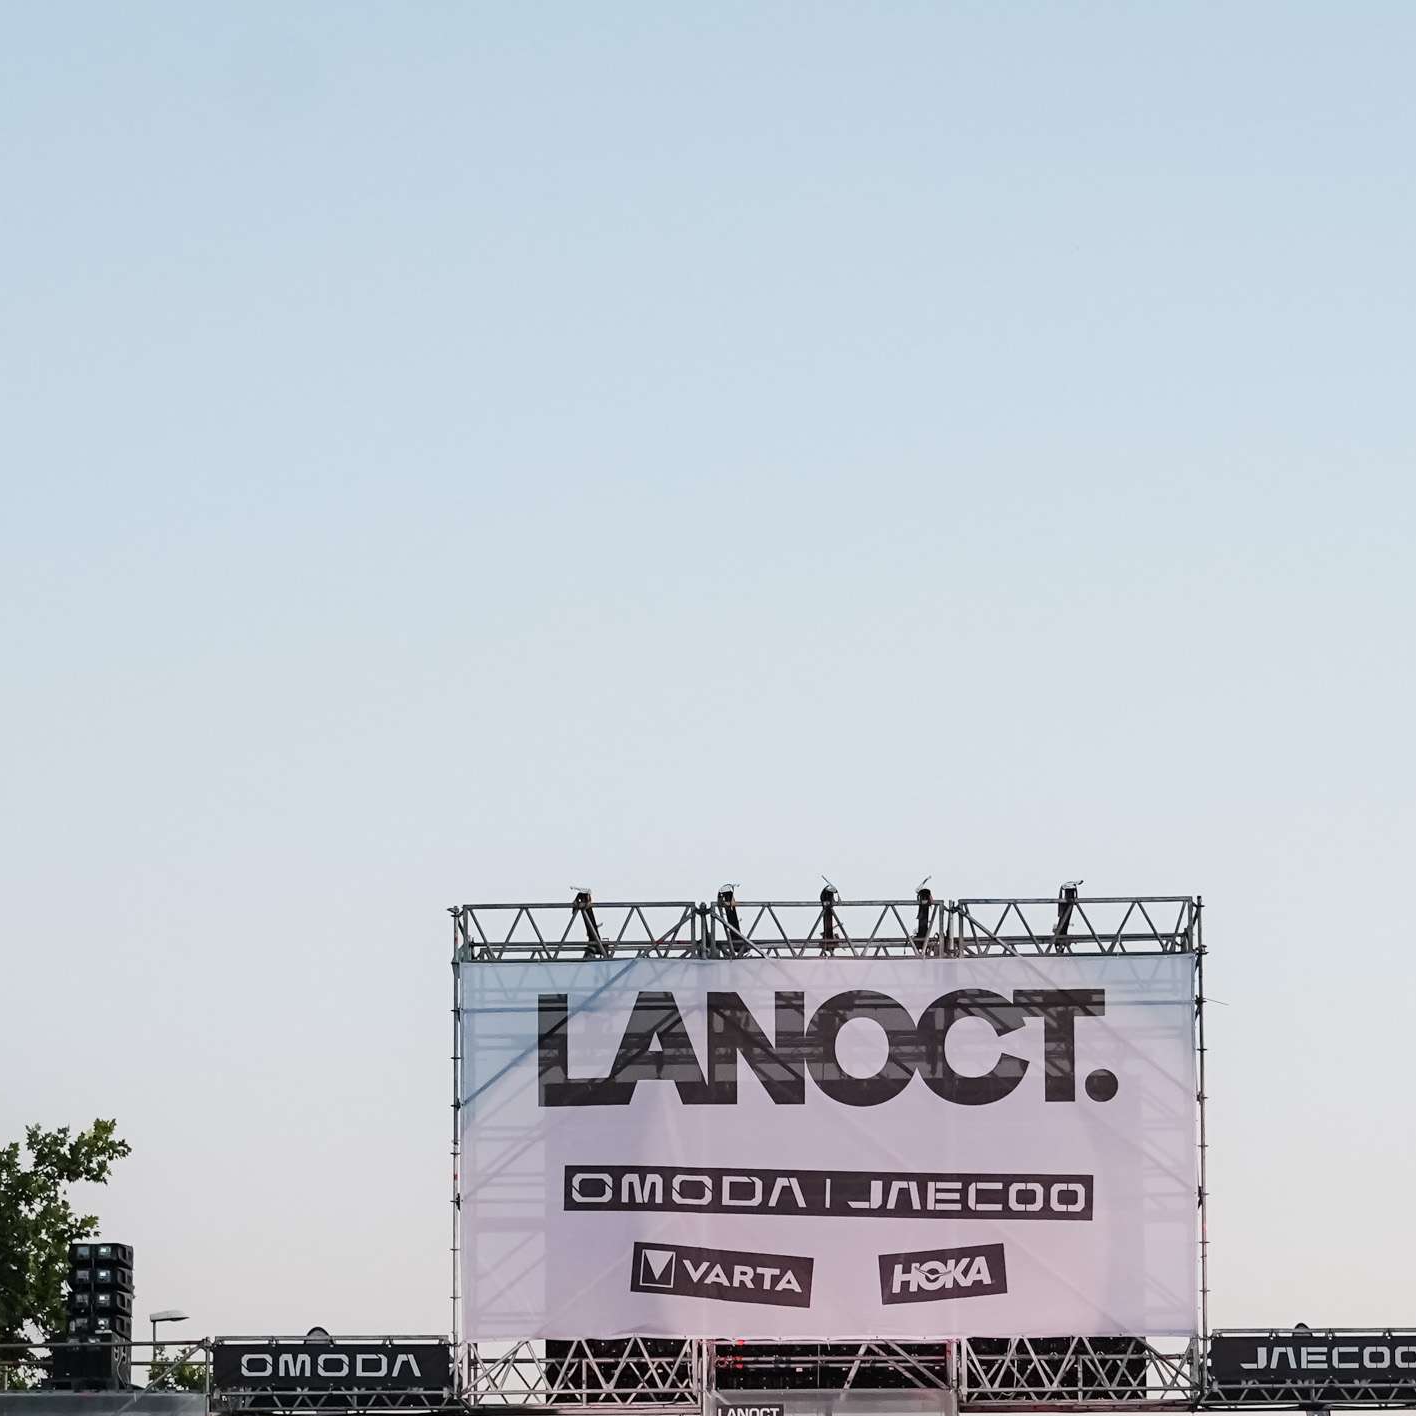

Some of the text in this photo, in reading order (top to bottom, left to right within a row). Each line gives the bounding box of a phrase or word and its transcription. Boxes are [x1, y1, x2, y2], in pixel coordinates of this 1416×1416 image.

[537, 988, 1120, 1107] LANOCT.
[571, 1172, 1086, 1213] OMODA JAECOO
[682, 1258, 803, 1294] VARTA
[891, 1254, 993, 1294] HOKA
[241, 1353, 423, 1378] OMODA
